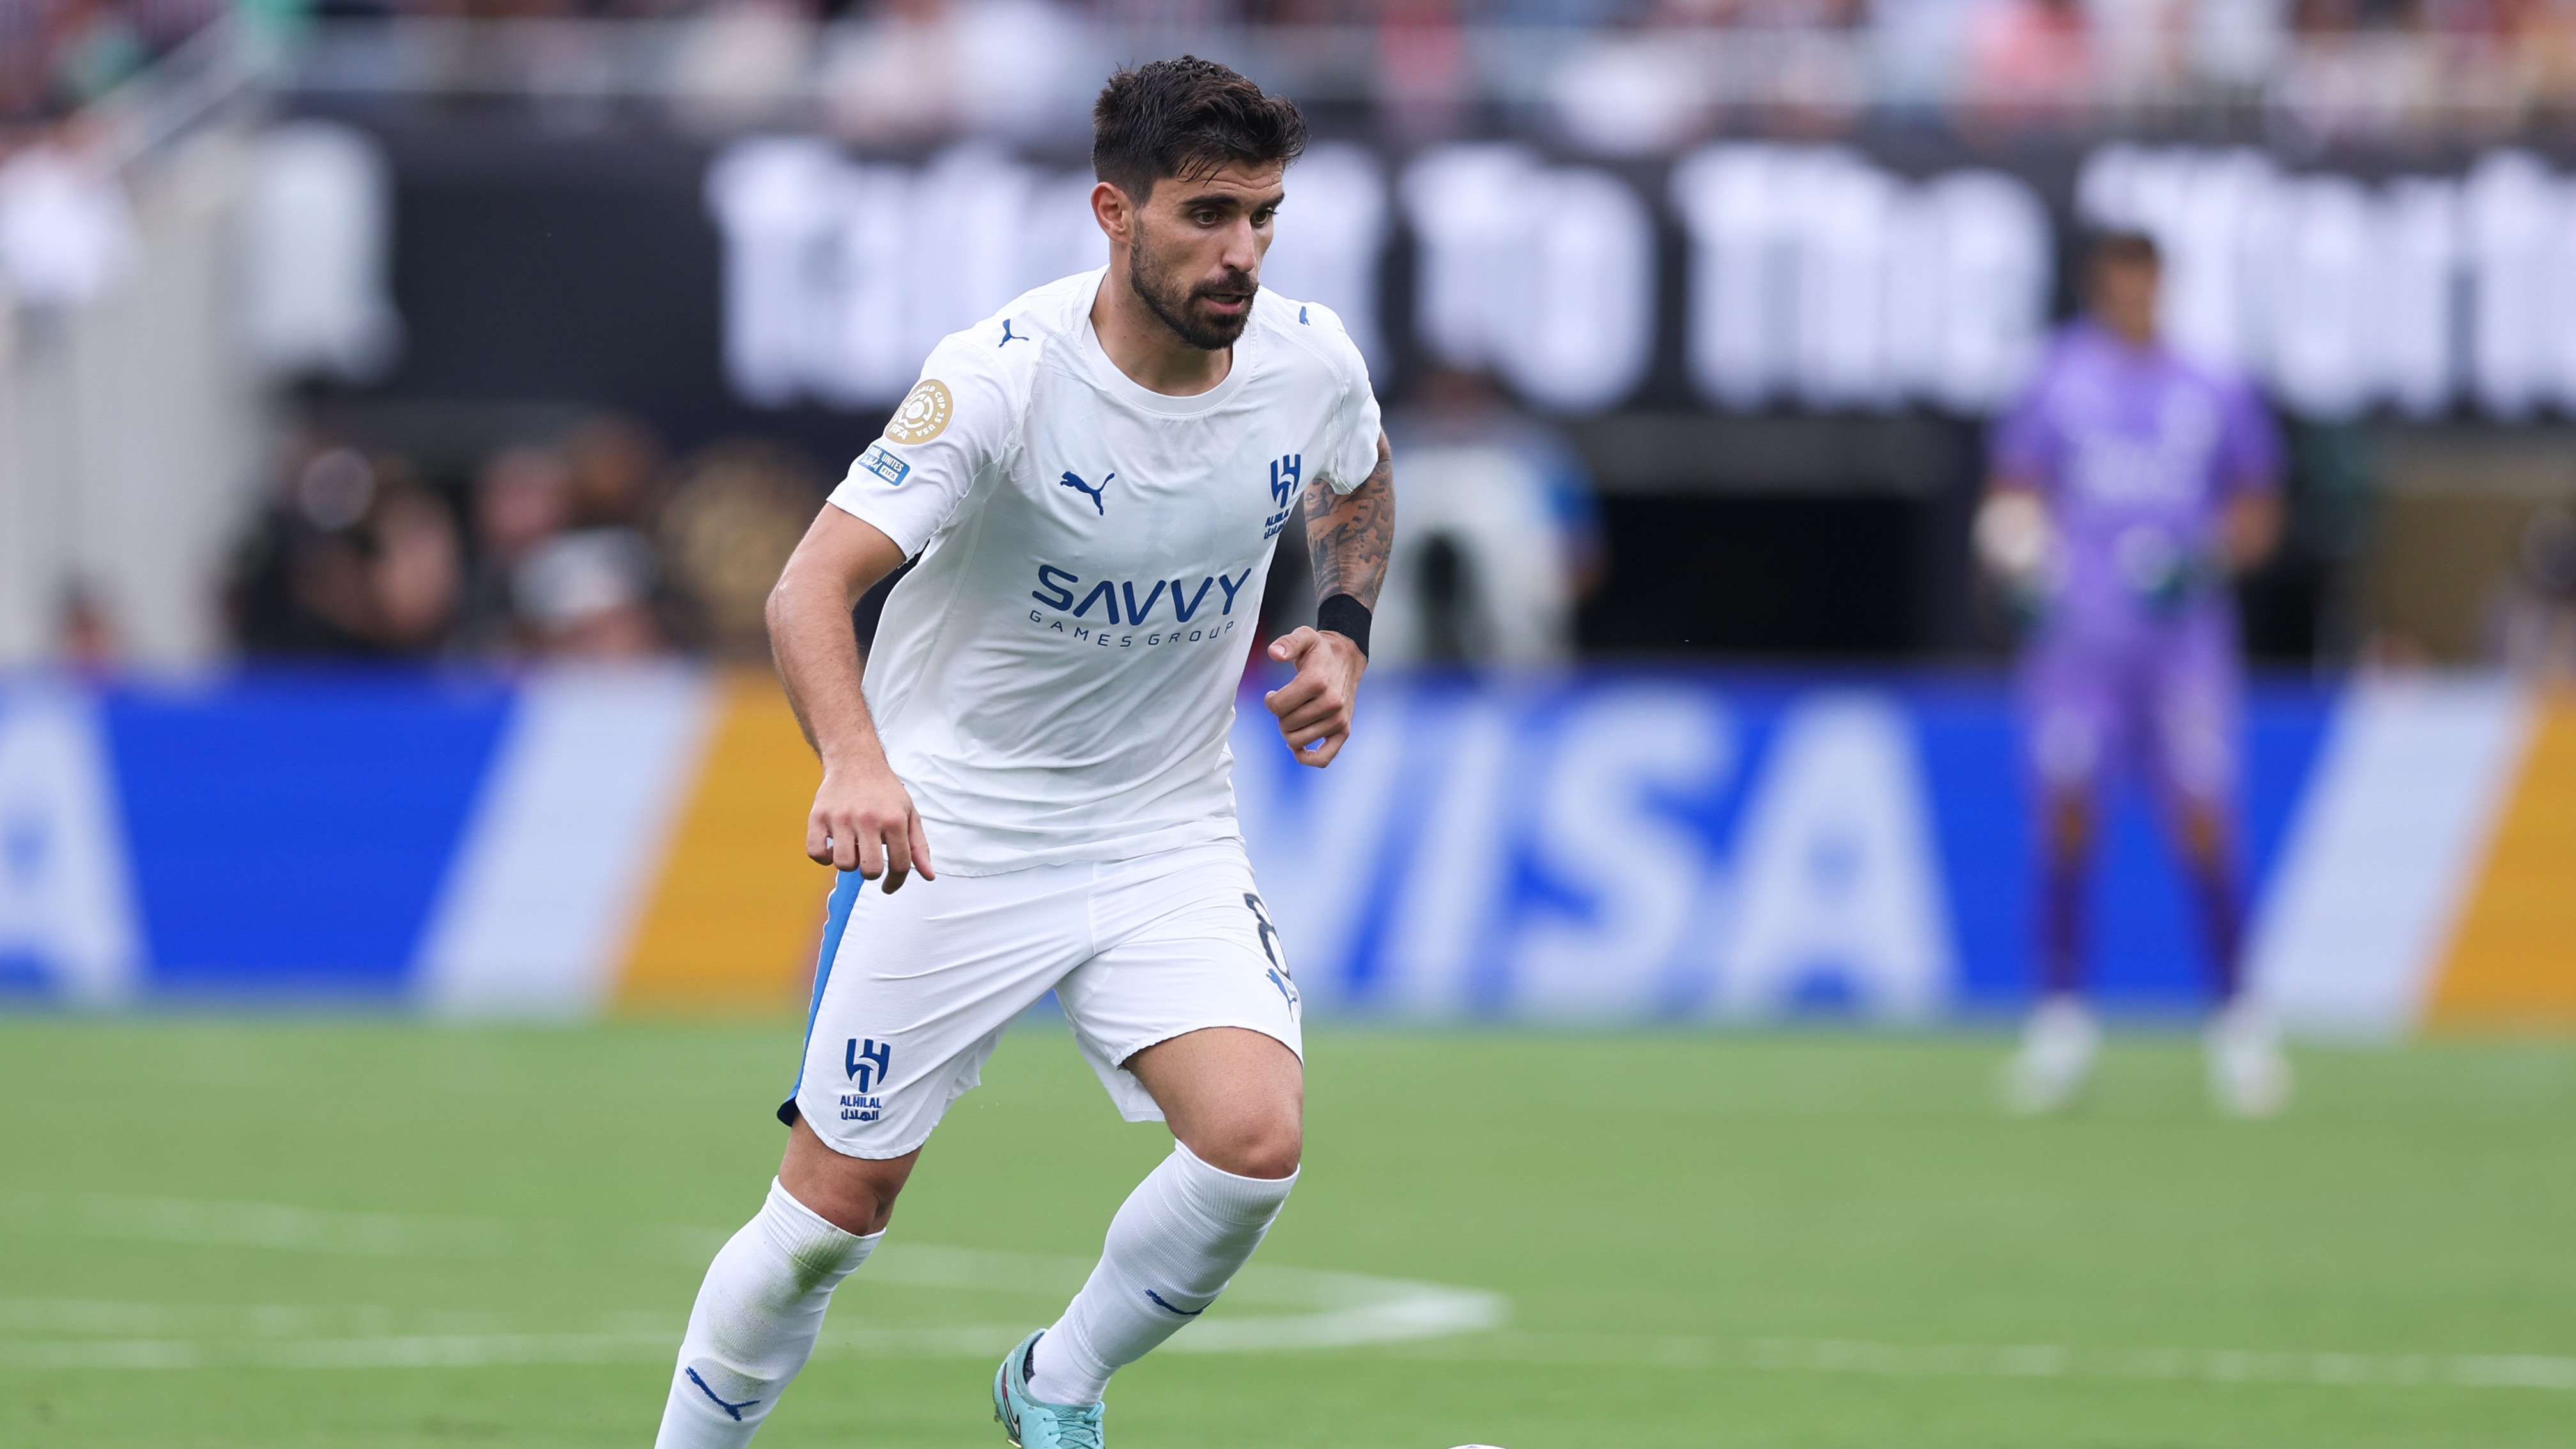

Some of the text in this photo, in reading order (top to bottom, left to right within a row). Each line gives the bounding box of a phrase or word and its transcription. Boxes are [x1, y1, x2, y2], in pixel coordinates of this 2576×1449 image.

[935, 392, 946, 409] CUP
[934, 412, 945, 424] 25
[916, 424, 936, 437] USA
[881, 453, 904, 472] UNITES
[881, 468, 895, 479] FIFA
[1032, 564, 1251, 626] SAVVY
[1030, 610, 1234, 647] GAMES GROUP
[1233, 690, 1952, 1007] VISA
[840, 1095, 882, 1108] ALHILAL
